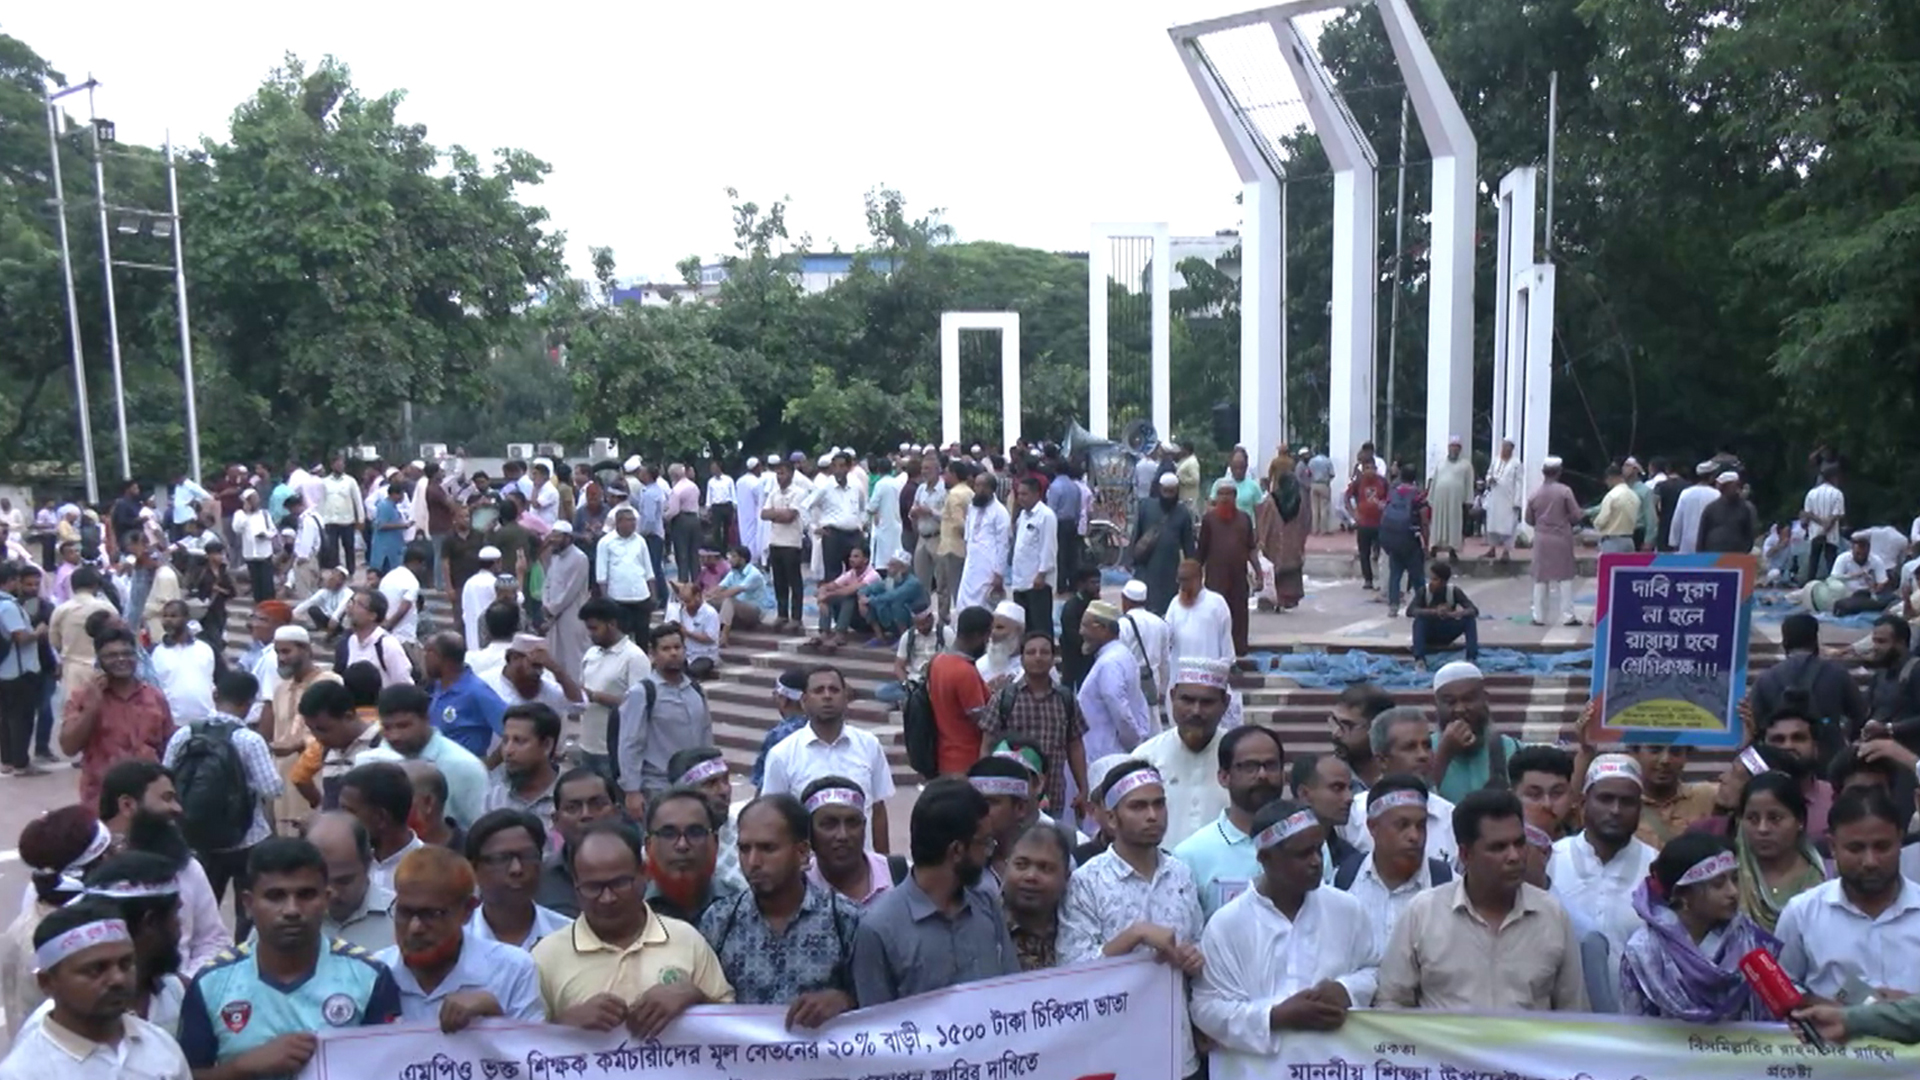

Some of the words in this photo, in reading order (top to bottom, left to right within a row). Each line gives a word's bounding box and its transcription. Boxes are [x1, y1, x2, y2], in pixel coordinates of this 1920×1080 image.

[1631, 574, 1671, 598] দাবি
[1675, 580, 1719, 603] পূরণ
[1642, 606, 1664, 624] না
[1668, 607, 1704, 626] হলে
[1684, 633, 1719, 652] হবে
[400, 1053, 472, 1080] এমপিও
[527, 1050, 588, 1080] শিক্ষক
[593, 1038, 702, 1073] কর্মচারীদের
[708, 1043, 738, 1071] মূল
[746, 1040, 819, 1063] বেতনের
[827, 1032, 876, 1061] ২০%
[936, 1021, 986, 1047] ১৫০০
[990, 1008, 1027, 1036] টাকা
[1031, 998, 1090, 1030] চিকিৎসা
[1093, 991, 1129, 1017] ভাতা
[985, 1049, 1040, 1079] দাবিতে
